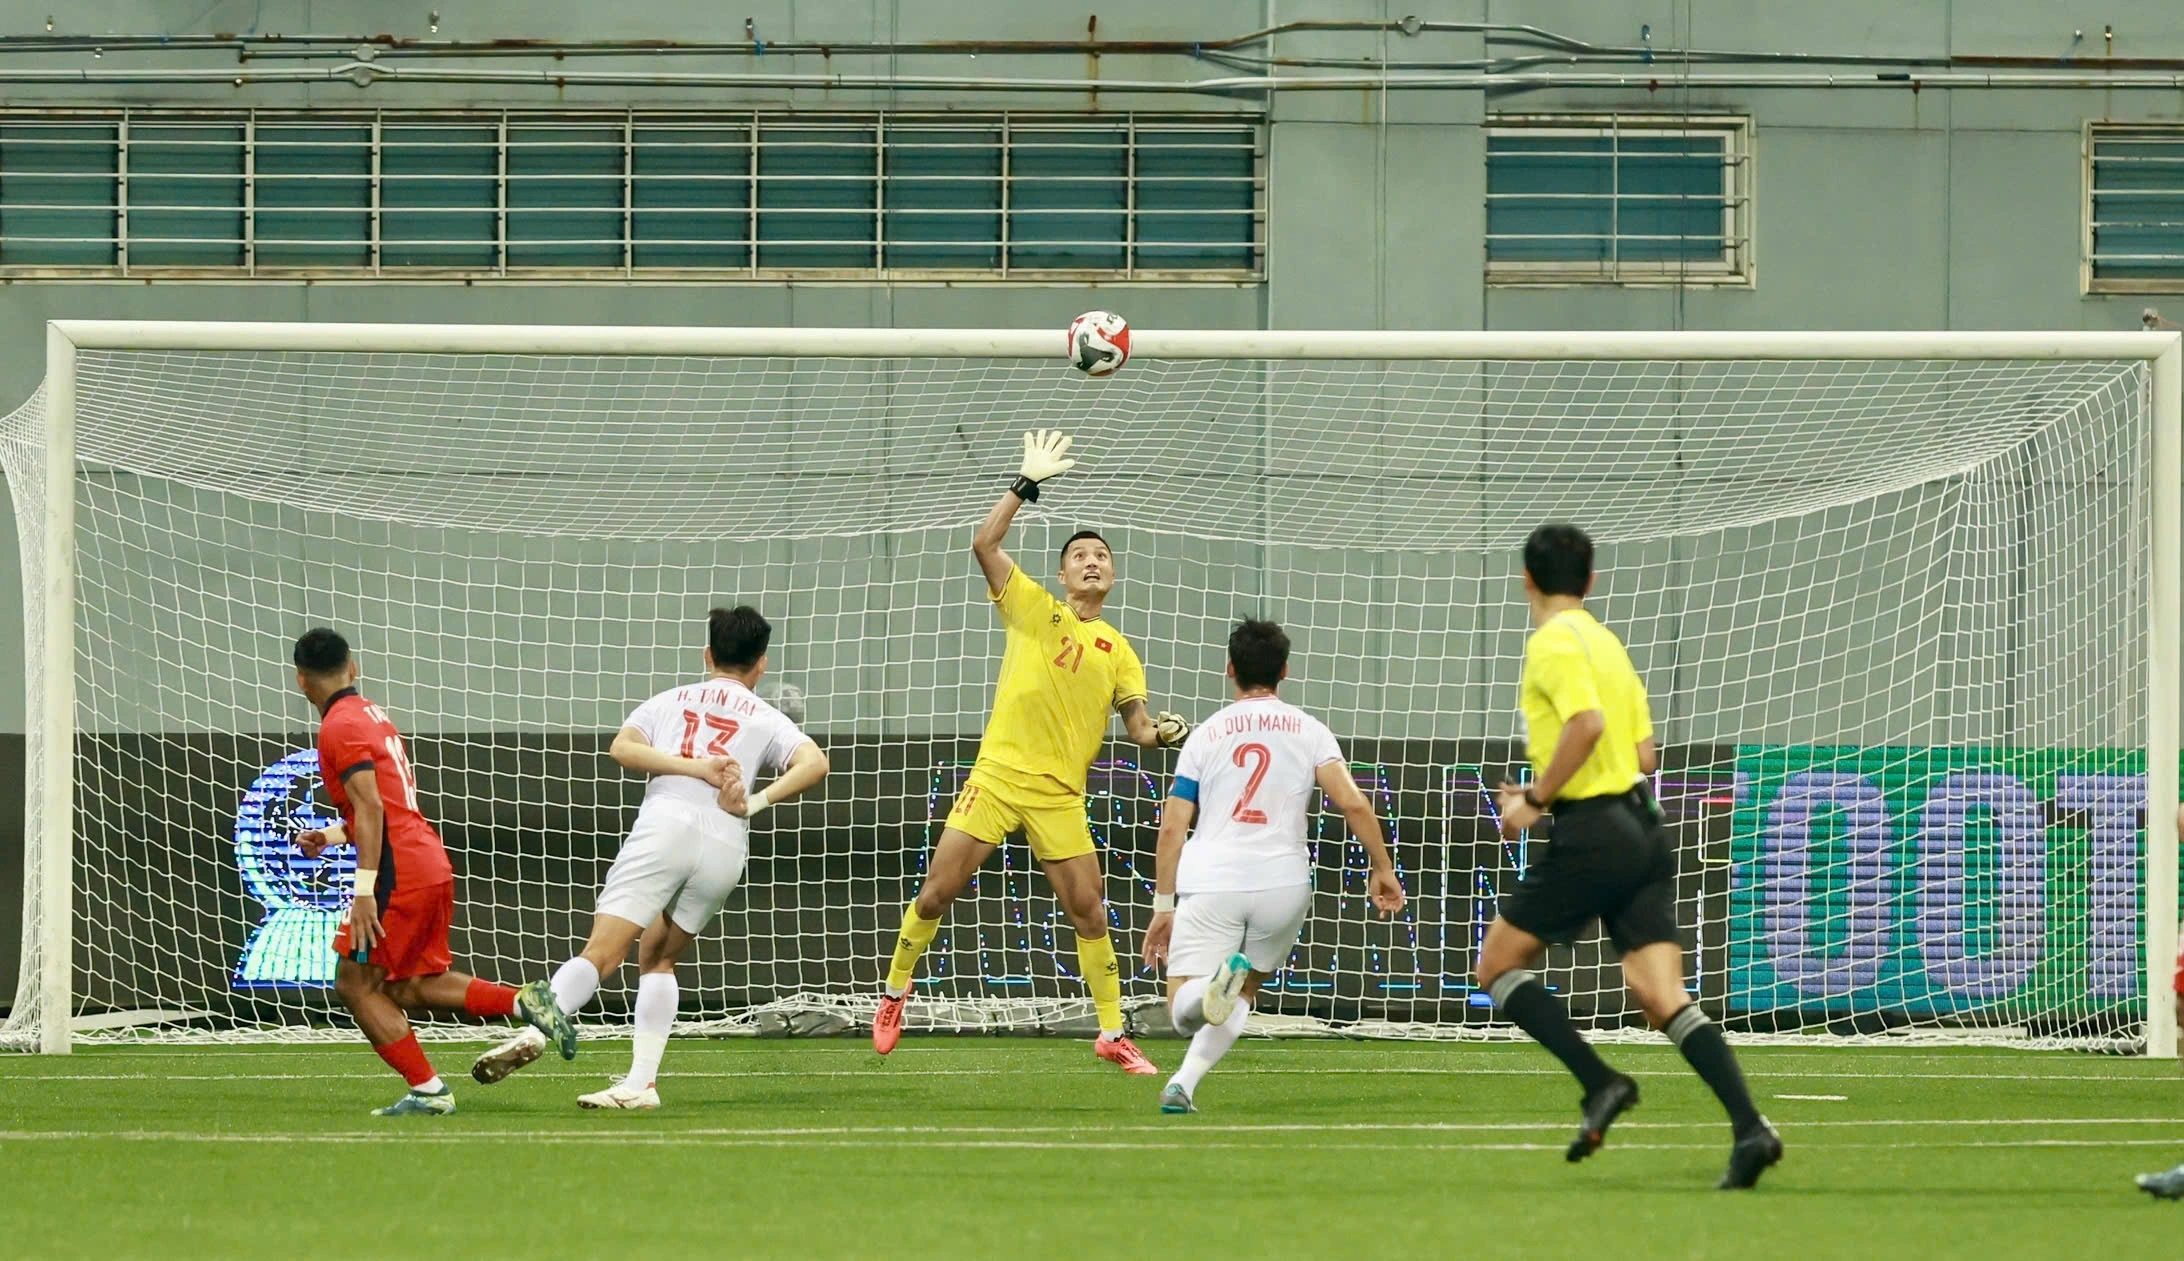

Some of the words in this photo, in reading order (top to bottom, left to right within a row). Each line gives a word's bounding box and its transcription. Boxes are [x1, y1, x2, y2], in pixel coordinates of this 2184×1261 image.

[1053, 636, 1084, 674] 21
[700, 688, 730, 707] TAN
[680, 708, 741, 759] 13
[1225, 713, 1254, 736] DUY
[1258, 714, 1304, 735] MANH
[1231, 742, 1272, 826] 2
